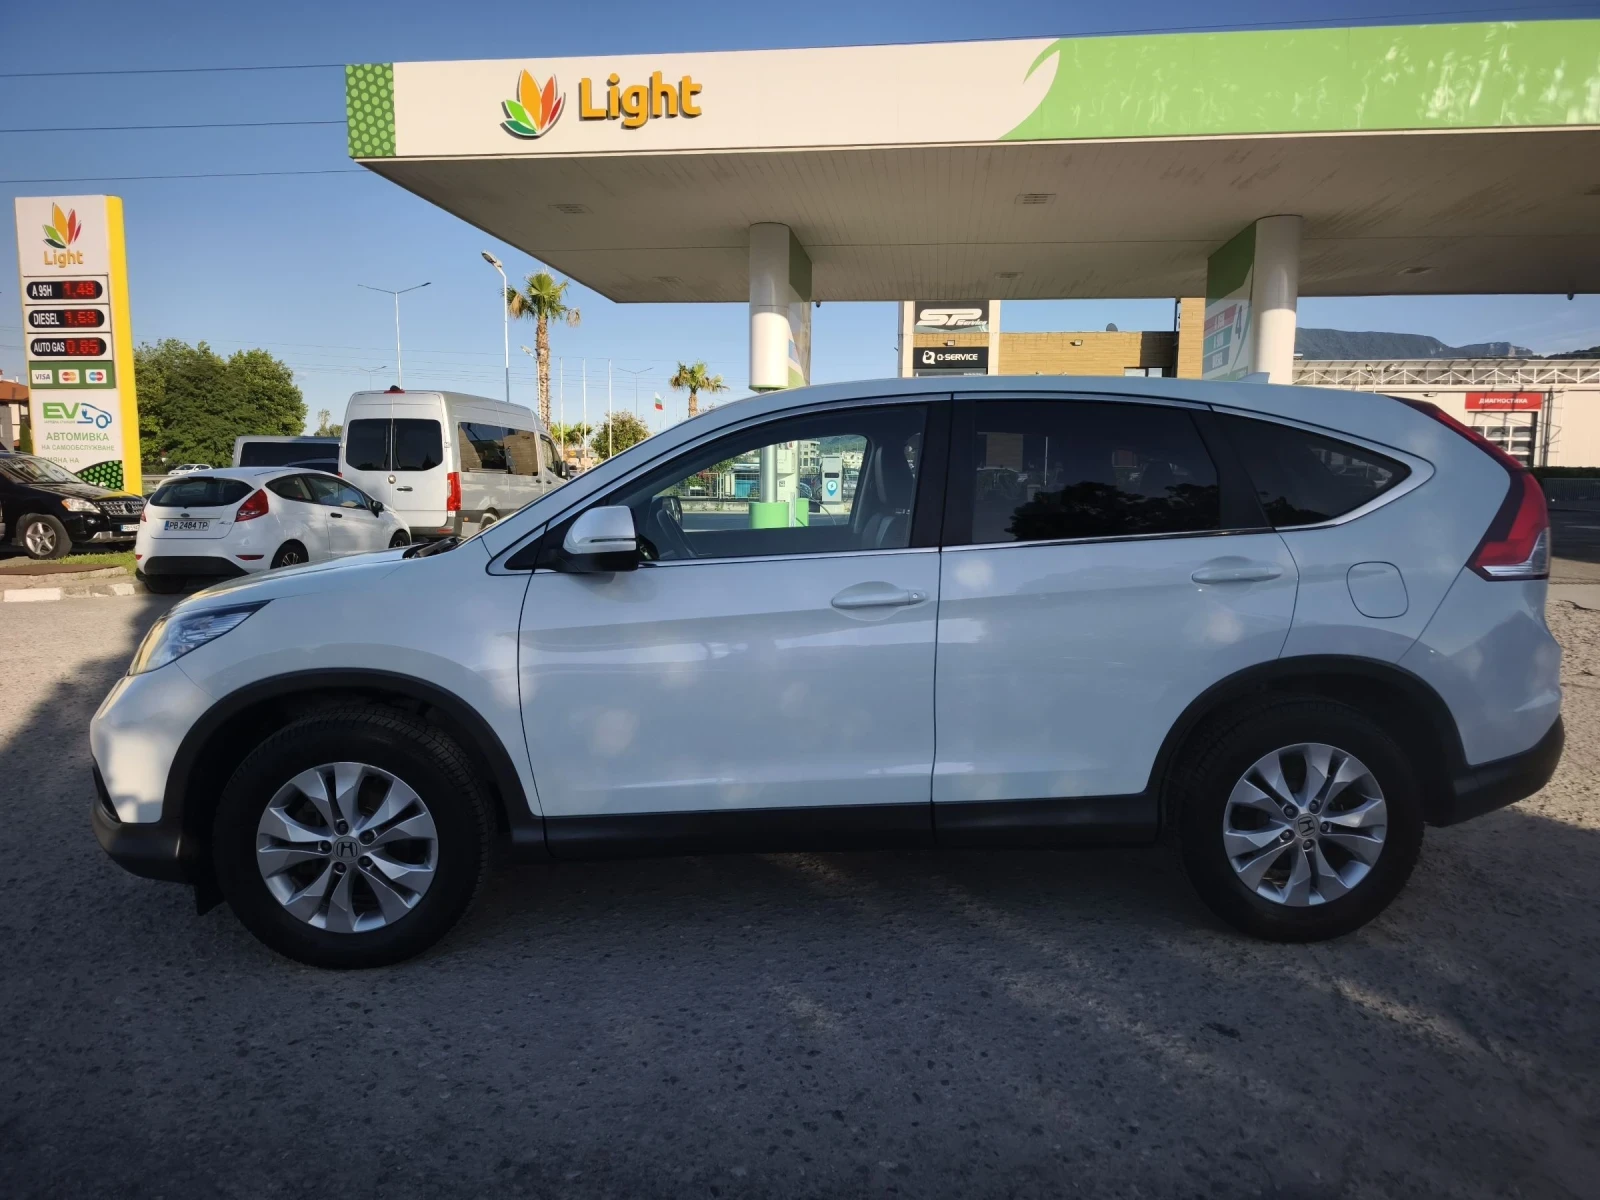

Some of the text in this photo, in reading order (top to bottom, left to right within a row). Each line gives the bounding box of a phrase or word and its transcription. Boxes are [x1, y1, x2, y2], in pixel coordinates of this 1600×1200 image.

[579, 70, 702, 128] Light
[43, 249, 84, 268] Light
[31, 285, 38, 297] A
[33, 312, 60, 325] DIESEL
[916, 308, 982, 326] SP
[33, 341, 65, 353] AUTO GAS
[42, 402, 80, 419] EV
[46, 432, 109, 441] АВТОМИВКА
[170, 521, 208, 529] PB 2484 TP
